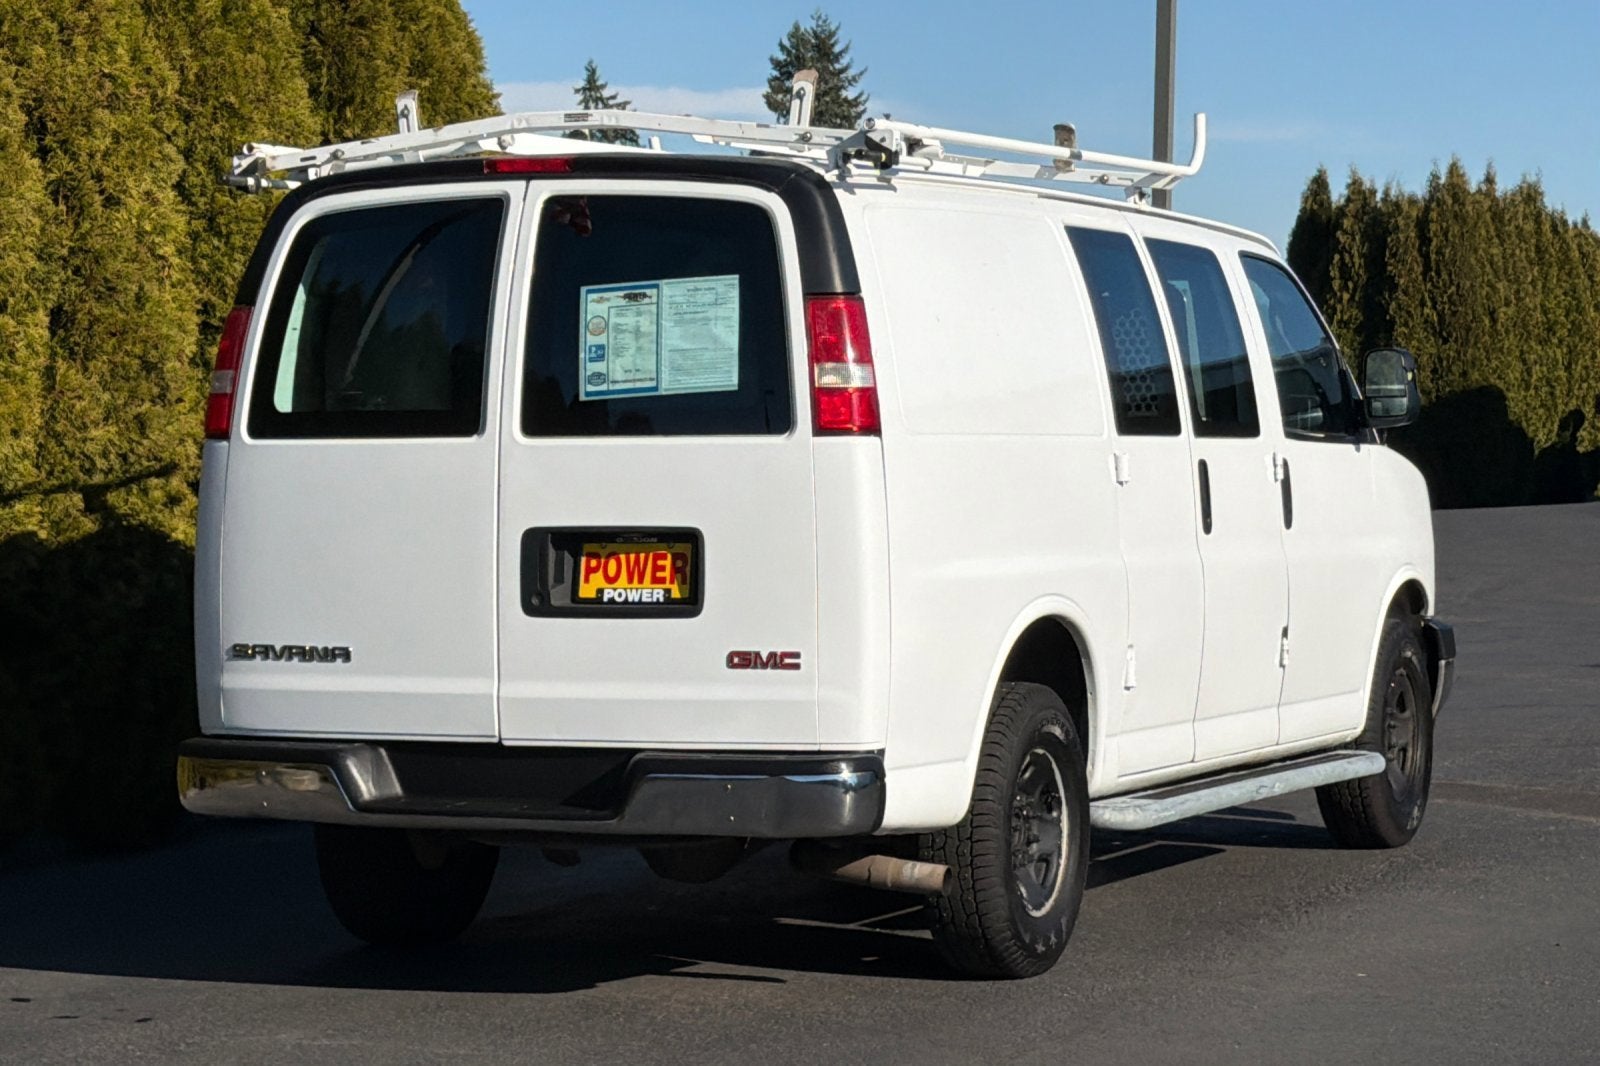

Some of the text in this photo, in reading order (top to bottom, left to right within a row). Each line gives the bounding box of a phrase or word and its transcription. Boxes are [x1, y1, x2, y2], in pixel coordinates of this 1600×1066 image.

[583, 551, 689, 585] POWER
[603, 588, 665, 602] POWER
[226, 643, 352, 663] SAVANA
[726, 651, 801, 670] GMC
